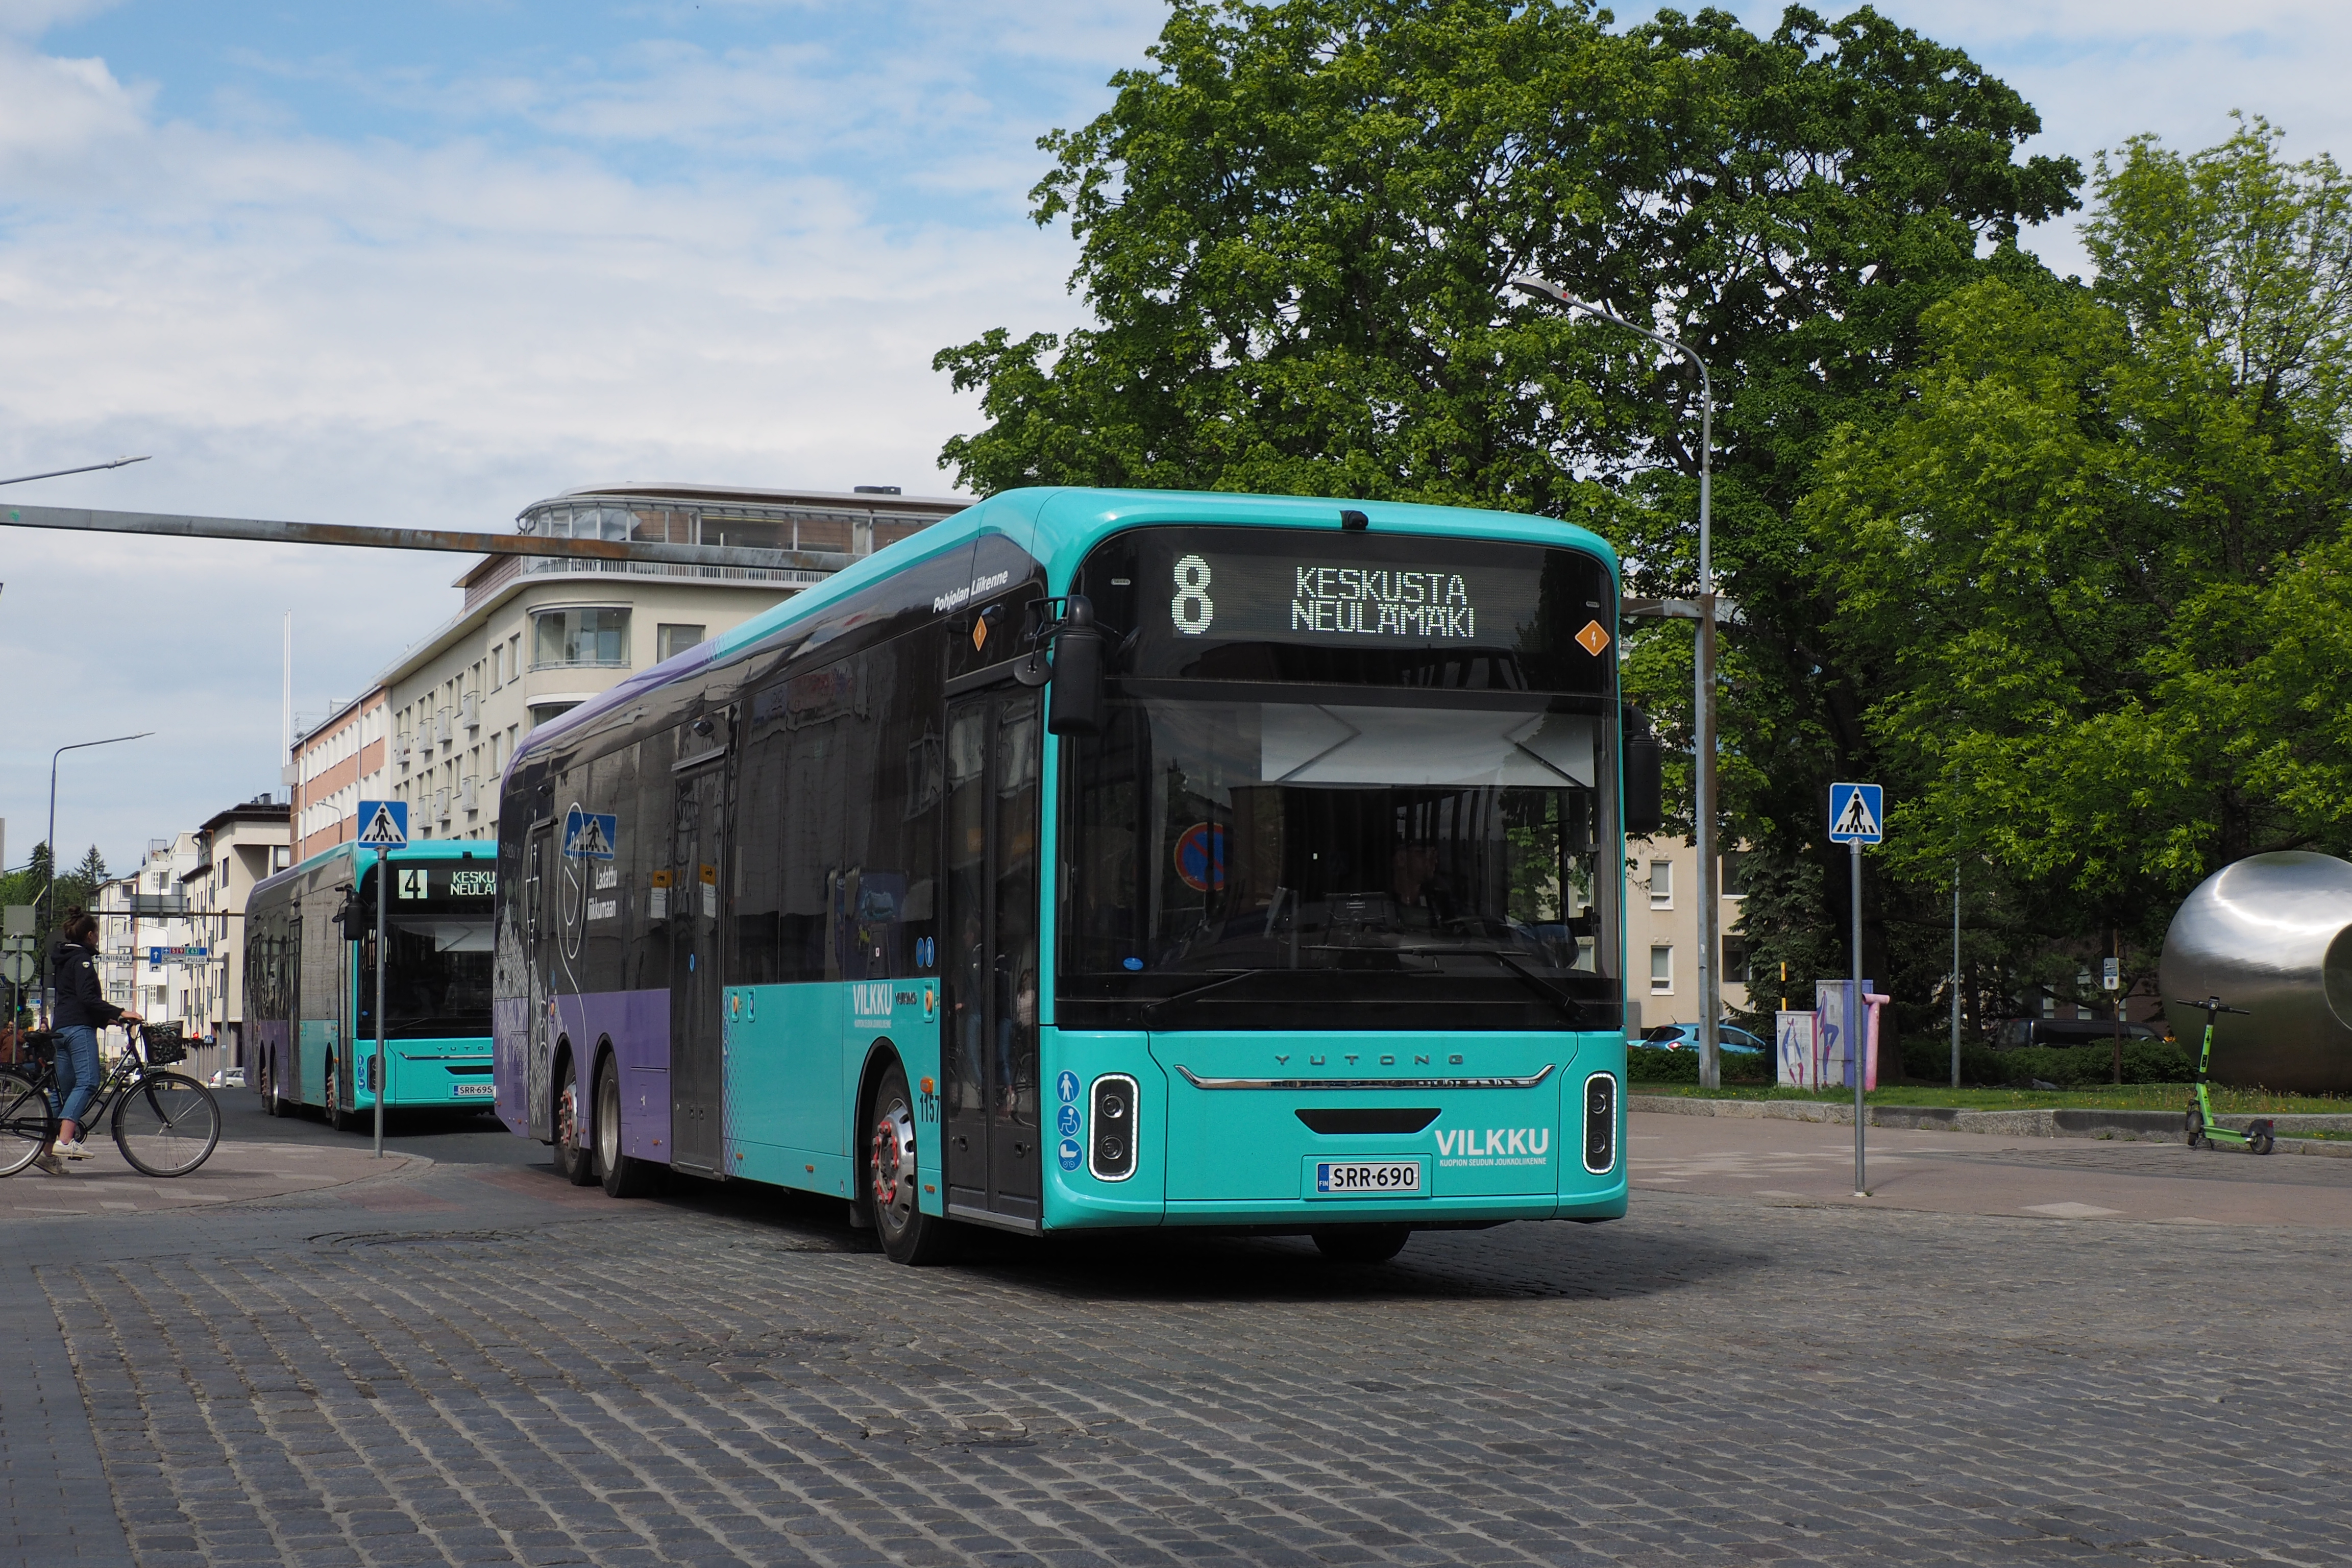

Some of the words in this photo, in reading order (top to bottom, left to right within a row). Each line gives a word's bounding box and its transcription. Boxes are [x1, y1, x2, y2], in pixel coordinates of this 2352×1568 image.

[933, 586, 970, 614] Pohjolan
[970, 570, 1009, 597] Liikenne
[1171, 554, 1214, 635] 8
[1296, 566, 1467, 605] KESKUSTA
[1292, 599, 1475, 638] NEULÄMÄKI
[404, 869, 422, 899] 4
[453, 871, 497, 883] KESKU
[595, 865, 617, 890] Ladattu
[587, 896, 616, 920] liikkumaan
[853, 983, 892, 1016] VILKKU
[1275, 1054, 1463, 1065] YUTONG
[460, 1086, 493, 1094] SRR-695
[919, 1094, 940, 1124] 1157
[1434, 1128, 1549, 1156] VILKKU
[1439, 1159, 1468, 1167] KUOPION
[1468, 1158, 1494, 1166] SEUDUN
[1494, 1157, 1547, 1166] JOUKKOLIIKENNE
[1334, 1167, 1414, 1187] SRR-690
